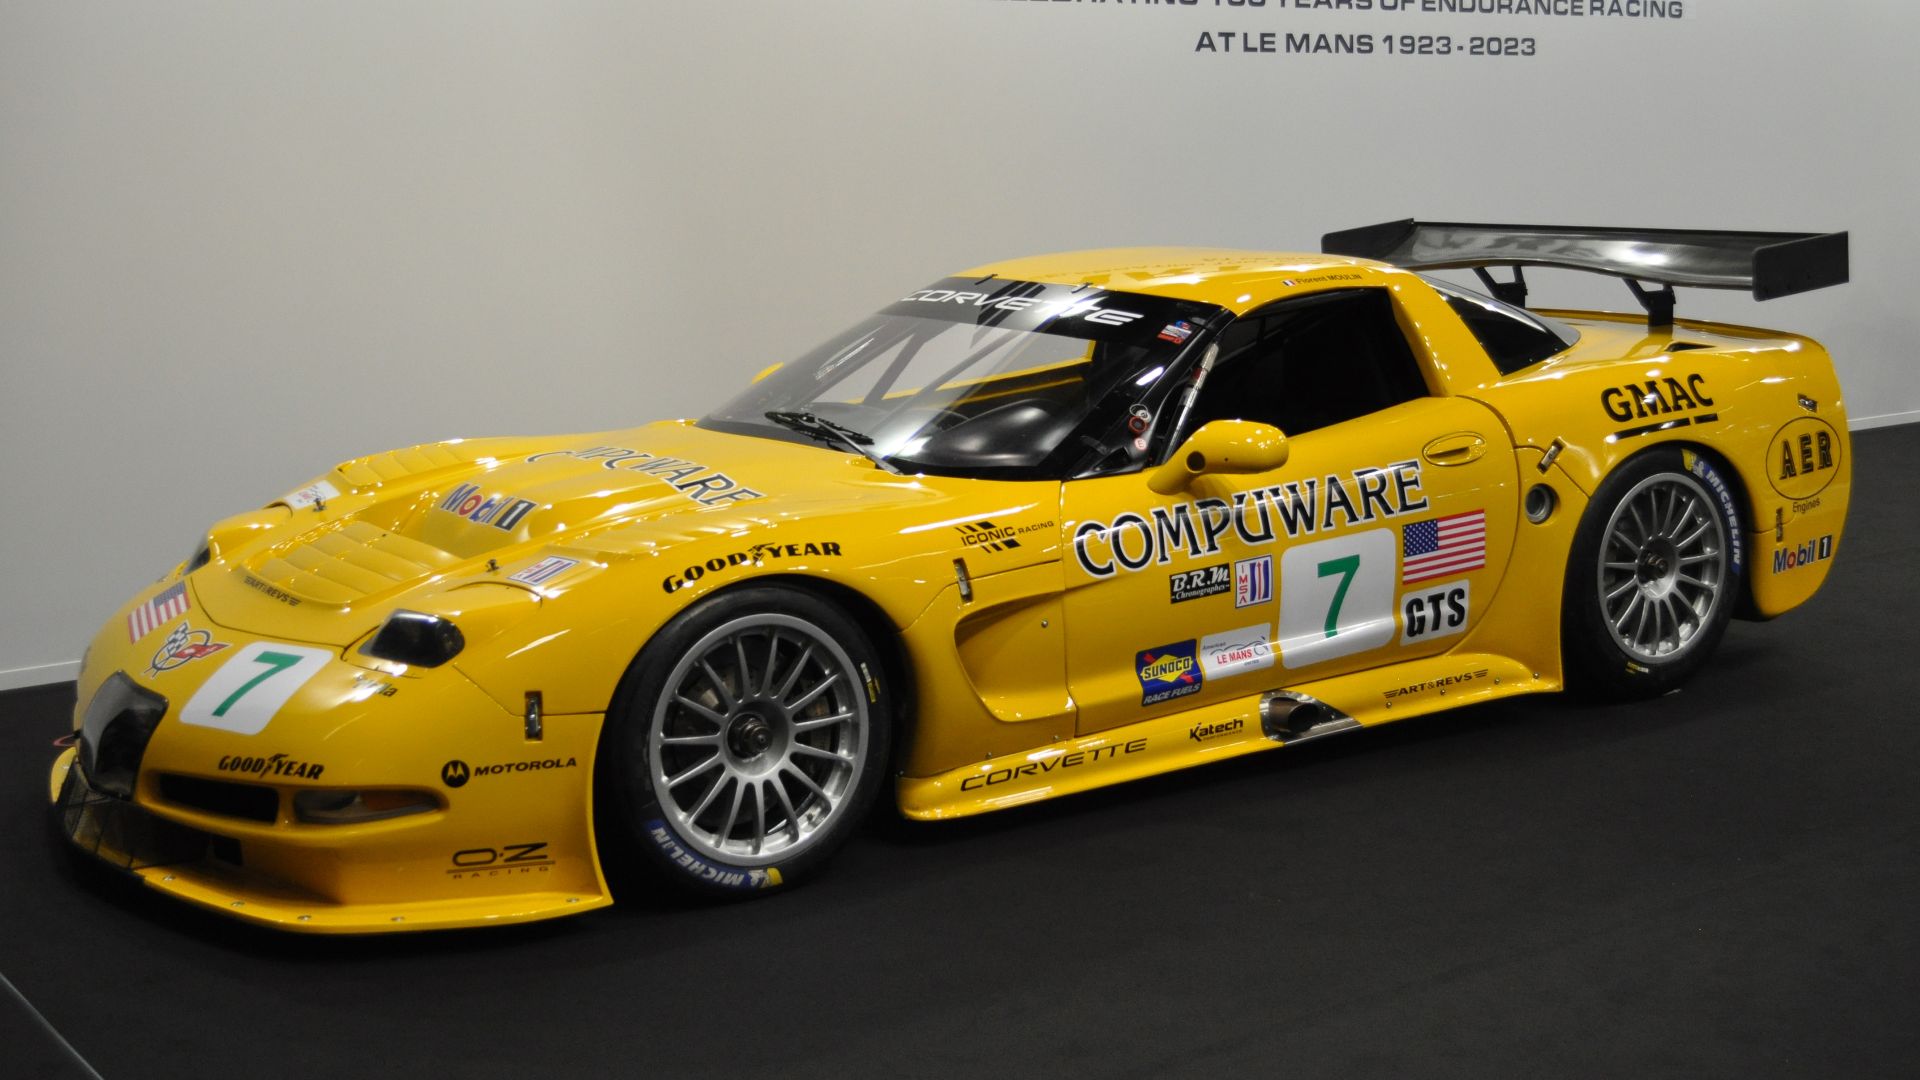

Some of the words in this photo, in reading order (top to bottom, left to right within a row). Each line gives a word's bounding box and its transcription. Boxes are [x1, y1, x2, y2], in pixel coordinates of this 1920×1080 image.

[1421, 0, 1584, 16] ENDURANCE
[1589, 0, 1683, 19] RACING
[1195, 31, 1236, 53] AT
[1242, 32, 1276, 53] LE
[1285, 33, 1374, 55] MANS
[1382, 35, 1451, 55] 1923
[1469, 36, 1536, 56] 2023
[902, 289, 1145, 326] CORVETTE
[1600, 373, 1714, 423] GMAC
[1779, 431, 1833, 480] AER
[440, 483, 515, 524] Mobil
[1073, 459, 1429, 578] COMPUWARE
[1706, 470, 1741, 565] MICHELIN
[1792, 497, 1821, 514] Engines
[960, 526, 1016, 547] ICONIC
[1017, 520, 1054, 534] RACING
[1772, 539, 1816, 574] Mobil
[1820, 536, 1831, 558] 1
[1317, 554, 1361, 639] 7
[1405, 588, 1465, 637] GTS
[1144, 657, 1191, 679] SUNOCO
[1216, 655, 1227, 665] LE
[1229, 648, 1252, 662] MANS
[211, 651, 304, 717] 7
[1143, 690, 1170, 705] RACE
[1171, 683, 1201, 699] FUELS
[1190, 719, 1243, 742] Katech
[474, 757, 577, 777] MOTOROLA
[960, 737, 1147, 792] CORVETTE
[453, 867, 549, 879] RACING
[651, 826, 744, 886] MICHELIN
